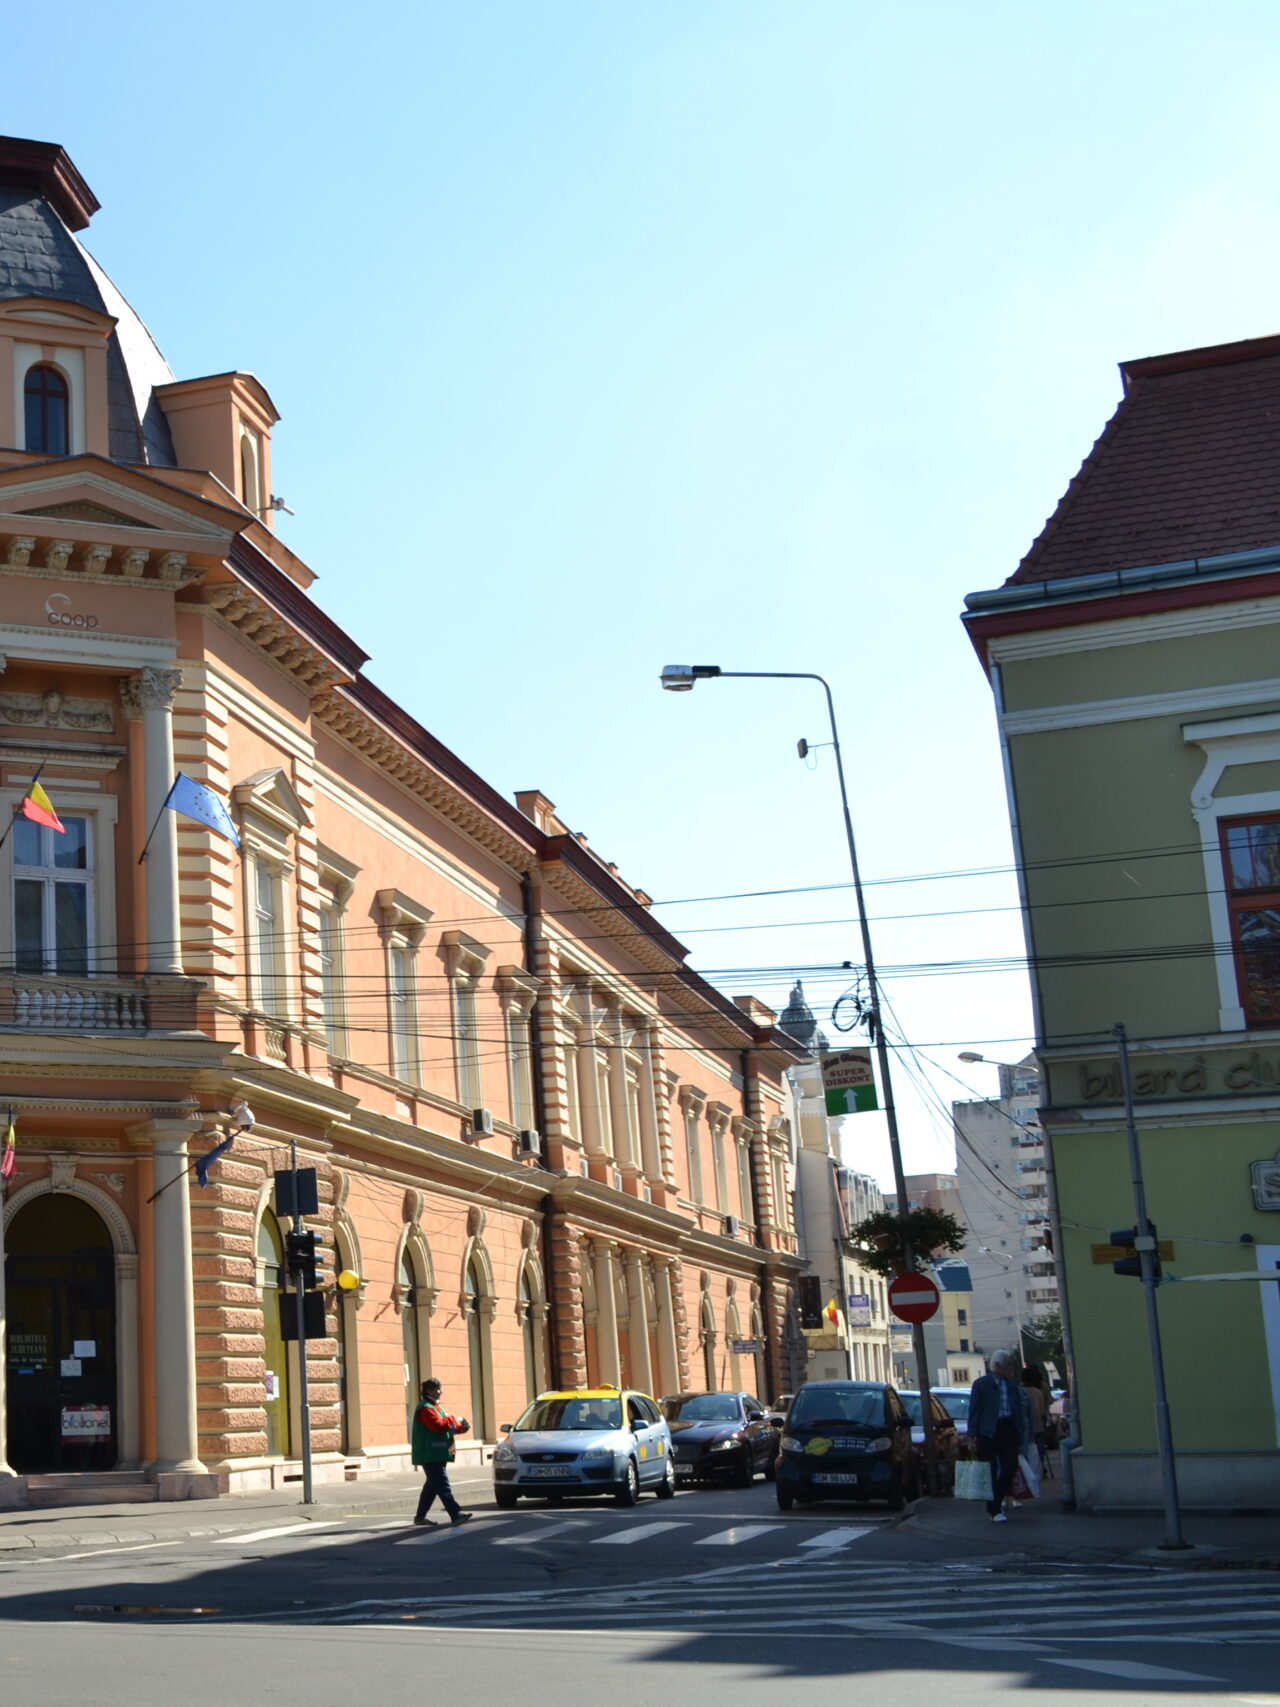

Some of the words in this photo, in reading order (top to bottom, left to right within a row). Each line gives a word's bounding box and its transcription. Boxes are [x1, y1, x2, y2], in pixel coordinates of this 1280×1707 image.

[48, 612, 98, 630] coop
[829, 1068, 865, 1078] SUPER
[826, 1075, 871, 1087] DISKONT
[9, 1334, 47, 1344] BIBLIOTECA
